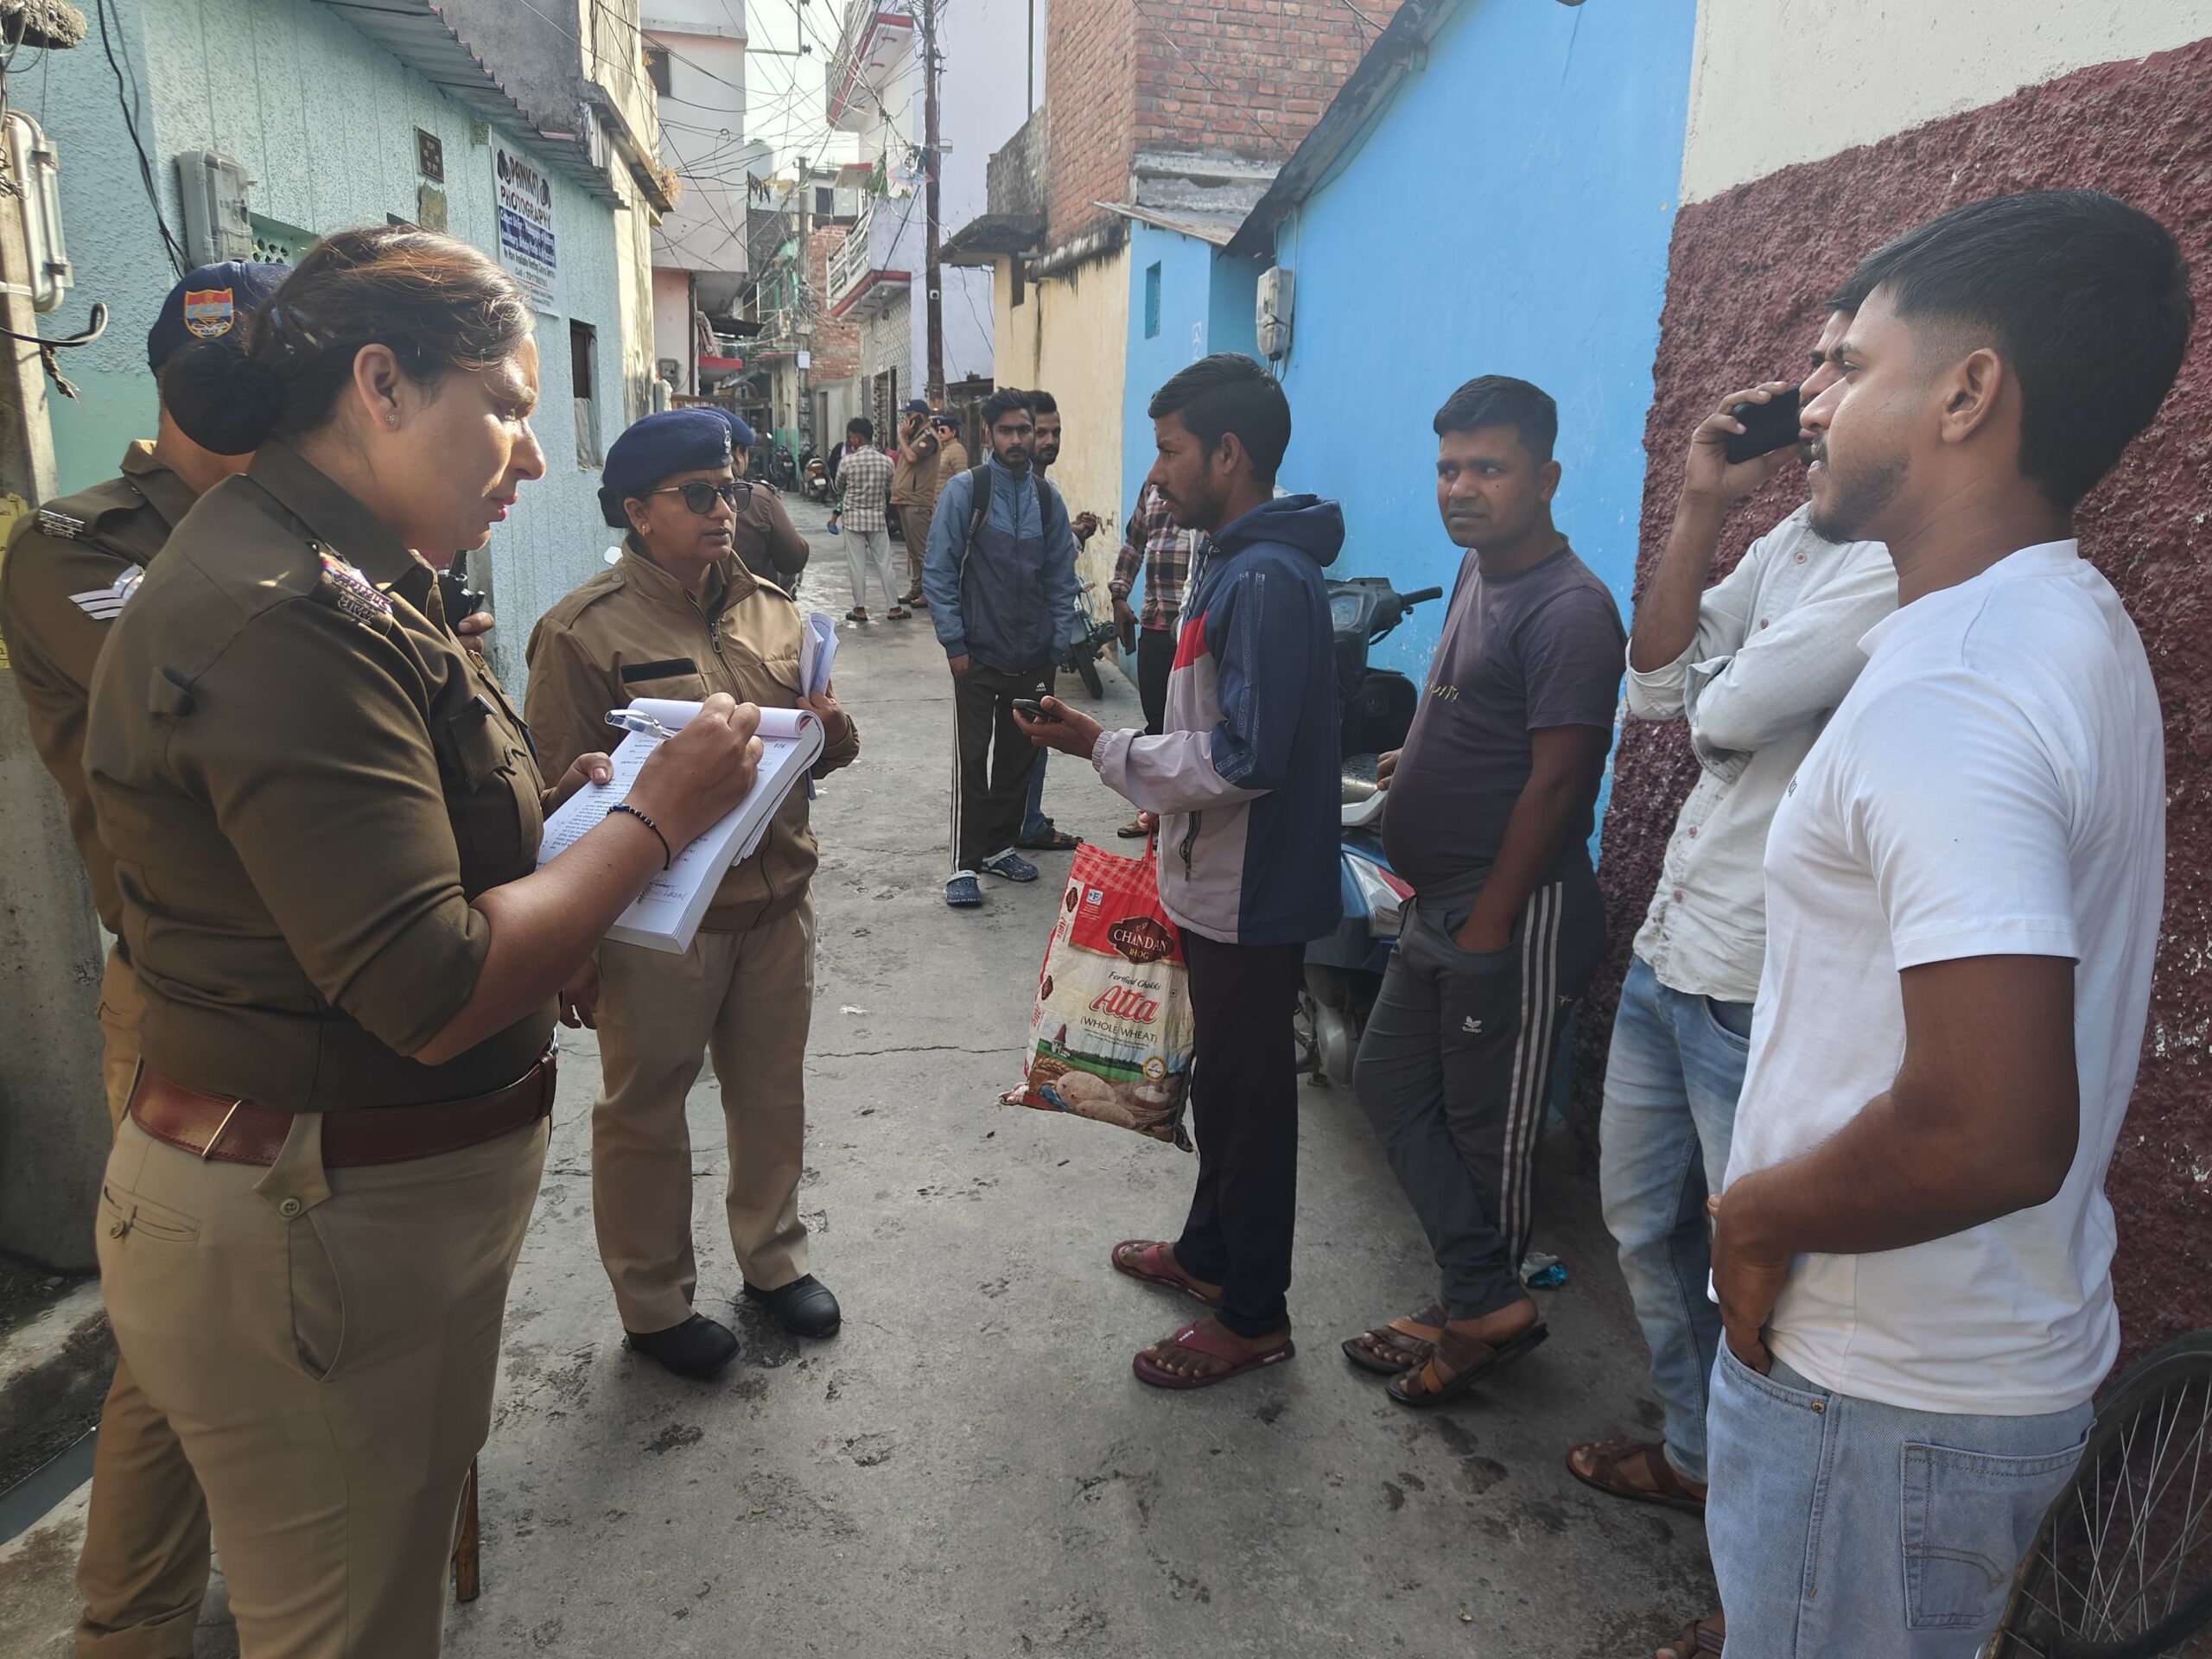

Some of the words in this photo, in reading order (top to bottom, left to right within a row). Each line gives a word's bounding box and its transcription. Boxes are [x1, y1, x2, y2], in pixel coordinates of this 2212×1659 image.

[509, 156, 539, 204] PANKAJ
[500, 185, 551, 230] PHOTOGRAPHY
[1114, 929, 1167, 952] CHANDAN
[1090, 984, 1160, 1024] Atta
[1080, 1016, 1118, 1034] (WHOLE
[1121, 1027, 1158, 1044] WHEAT)
